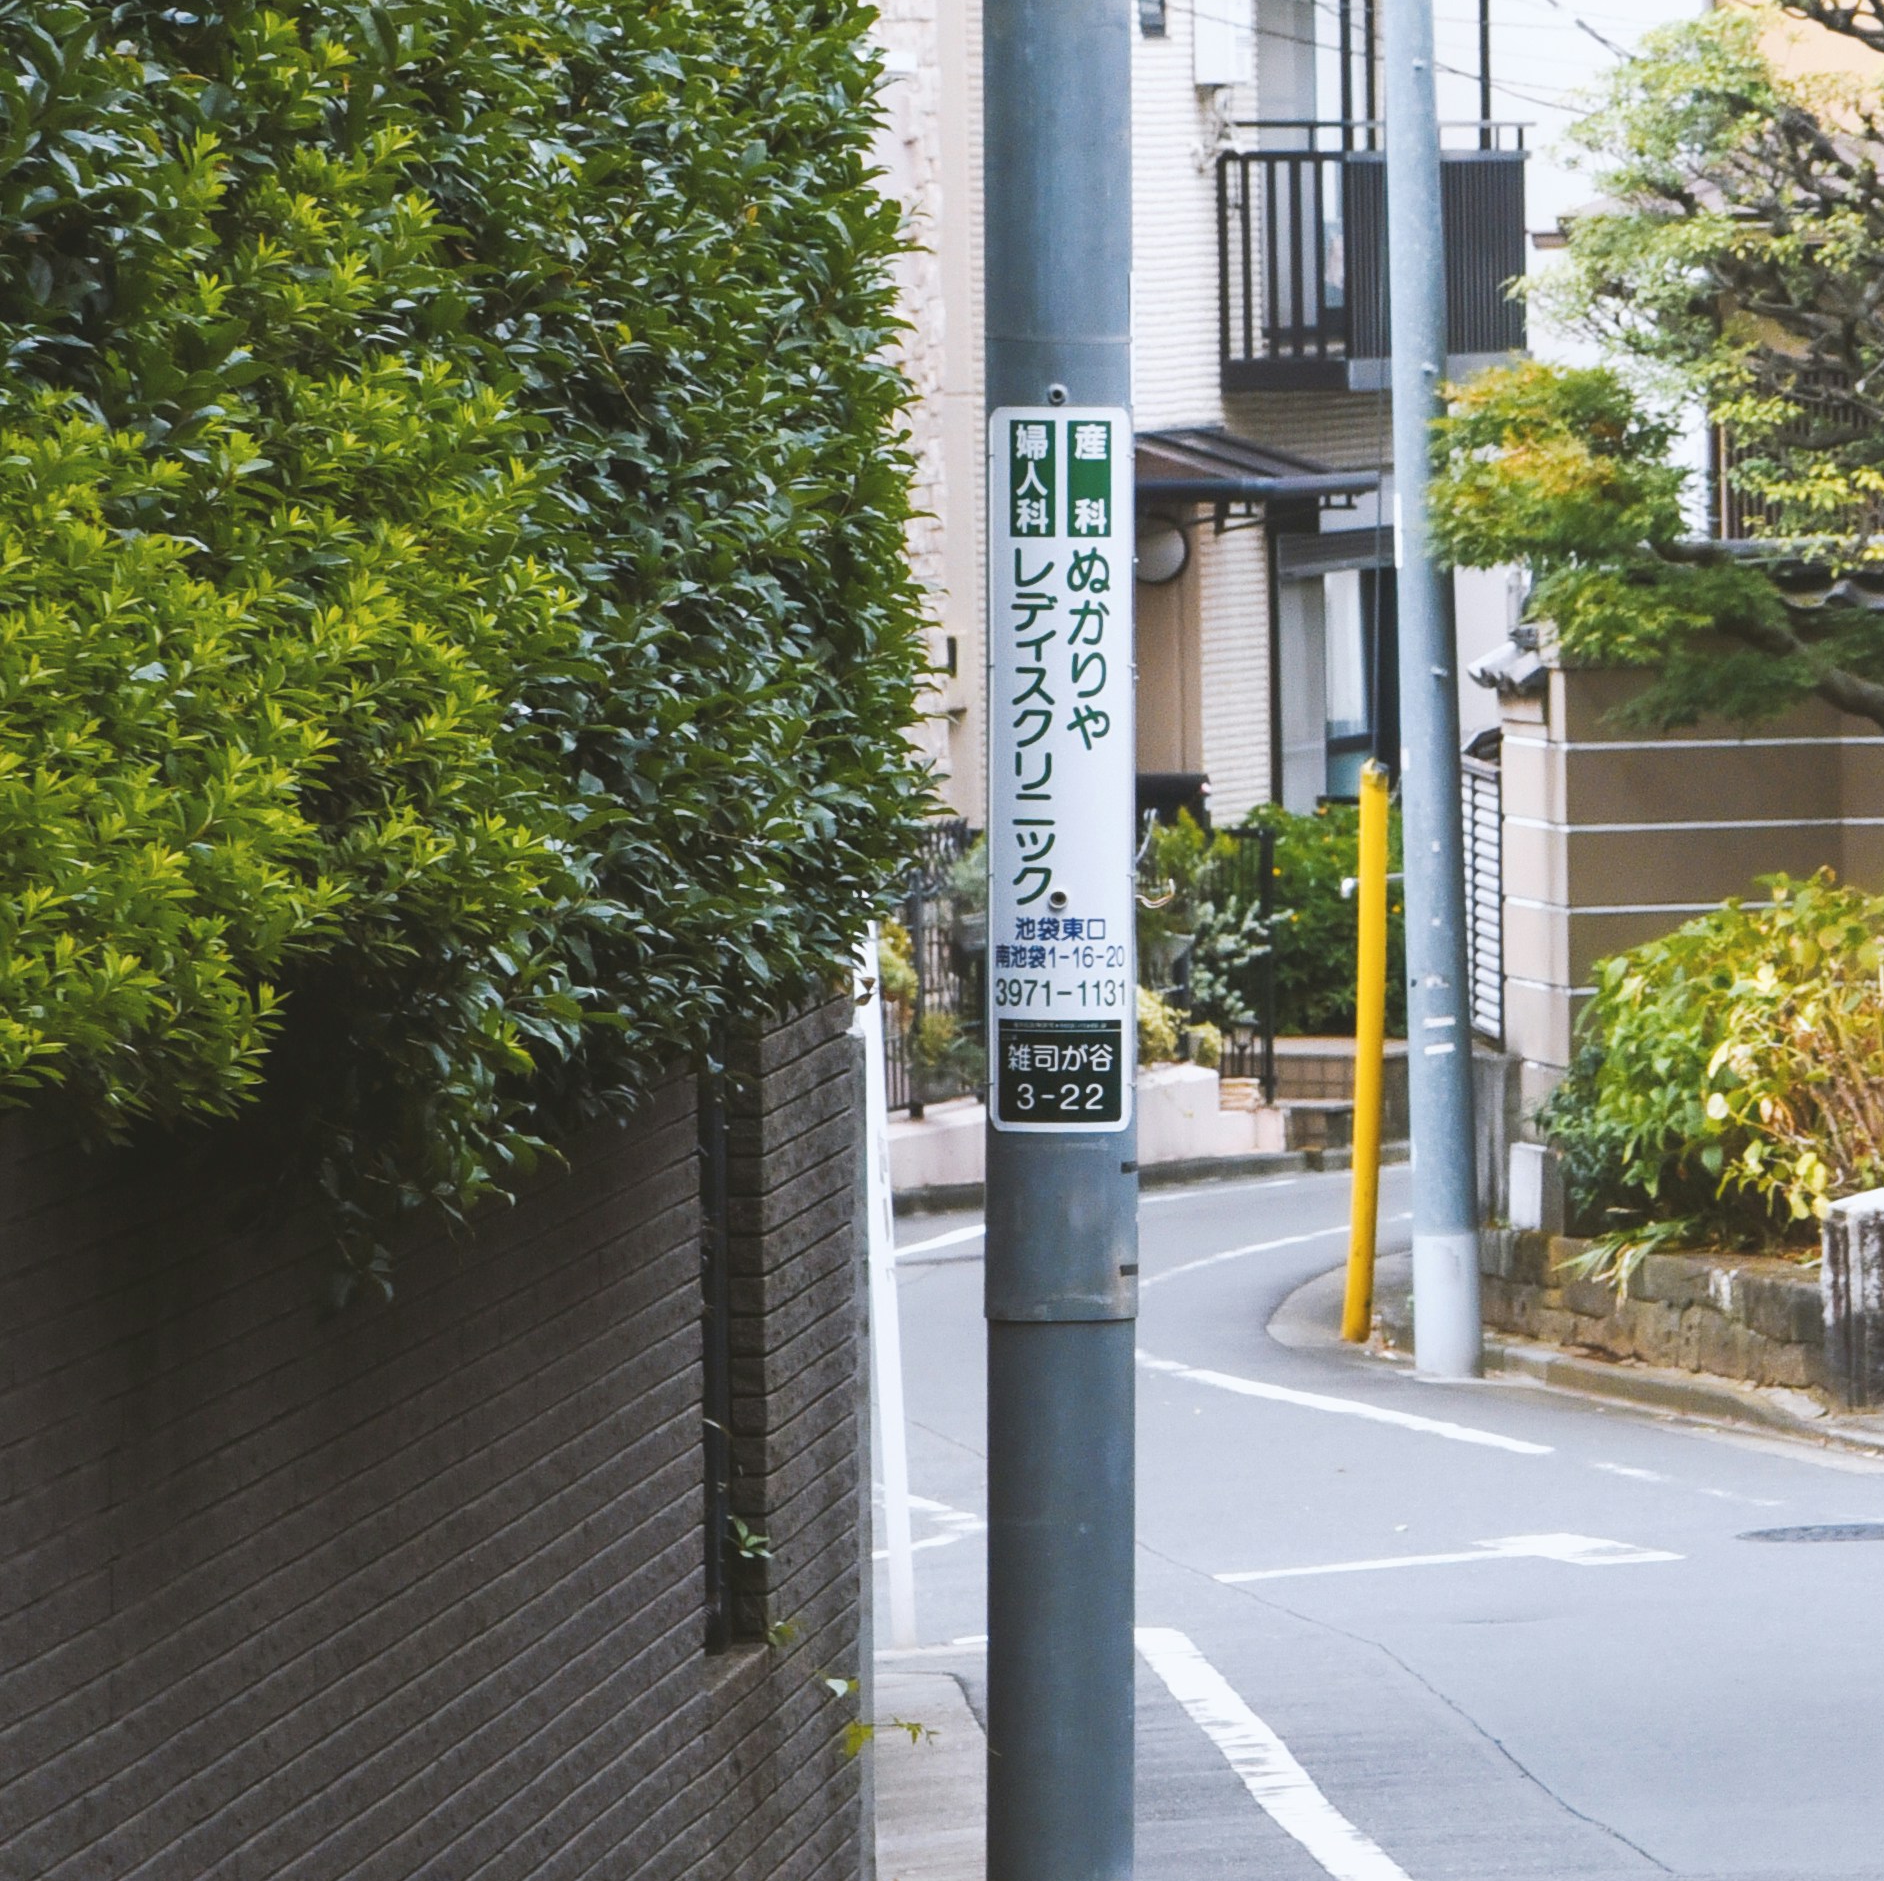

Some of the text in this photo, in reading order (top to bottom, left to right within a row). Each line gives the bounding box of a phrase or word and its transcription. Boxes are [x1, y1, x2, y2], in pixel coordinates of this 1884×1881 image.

[1016, 425, 1049, 534] 婦人科
[1074, 425, 1108, 534] 産科
[1066, 547, 1110, 751] ぬかりや
[1011, 547, 1058, 906] レディスクリニック
[1015, 917, 1106, 941] 池袋東口
[996, 978, 1125, 1007] 3971-1131
[1007, 1043, 1113, 1073] 雑司が谷
[1016, 1082, 1105, 1111] 3-22
